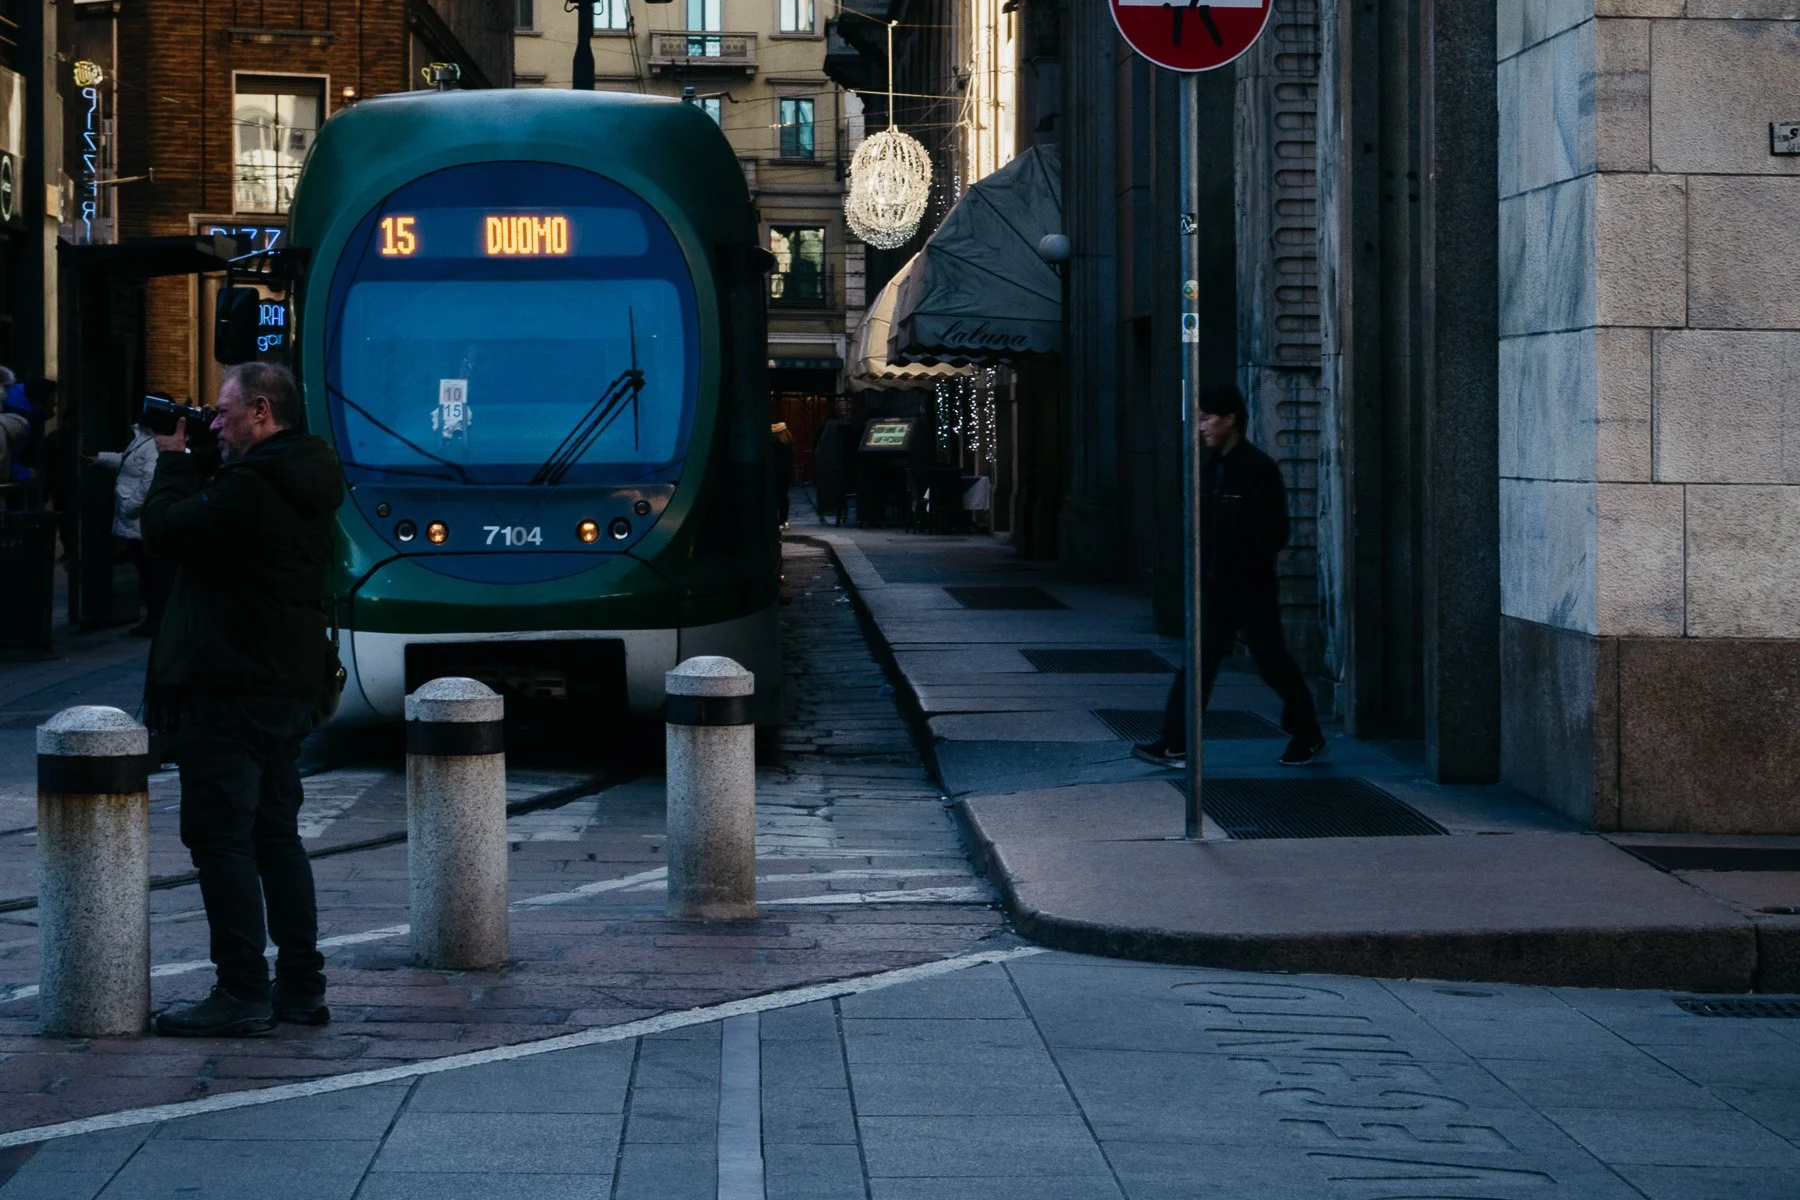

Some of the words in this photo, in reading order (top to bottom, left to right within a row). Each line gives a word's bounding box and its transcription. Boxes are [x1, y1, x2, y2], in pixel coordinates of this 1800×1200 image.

[381, 216, 416, 255] 15
[486, 215, 568, 255] DUOMO
[443, 386, 463, 402] 10
[443, 403, 462, 418] 15
[483, 525, 544, 547] 7104
